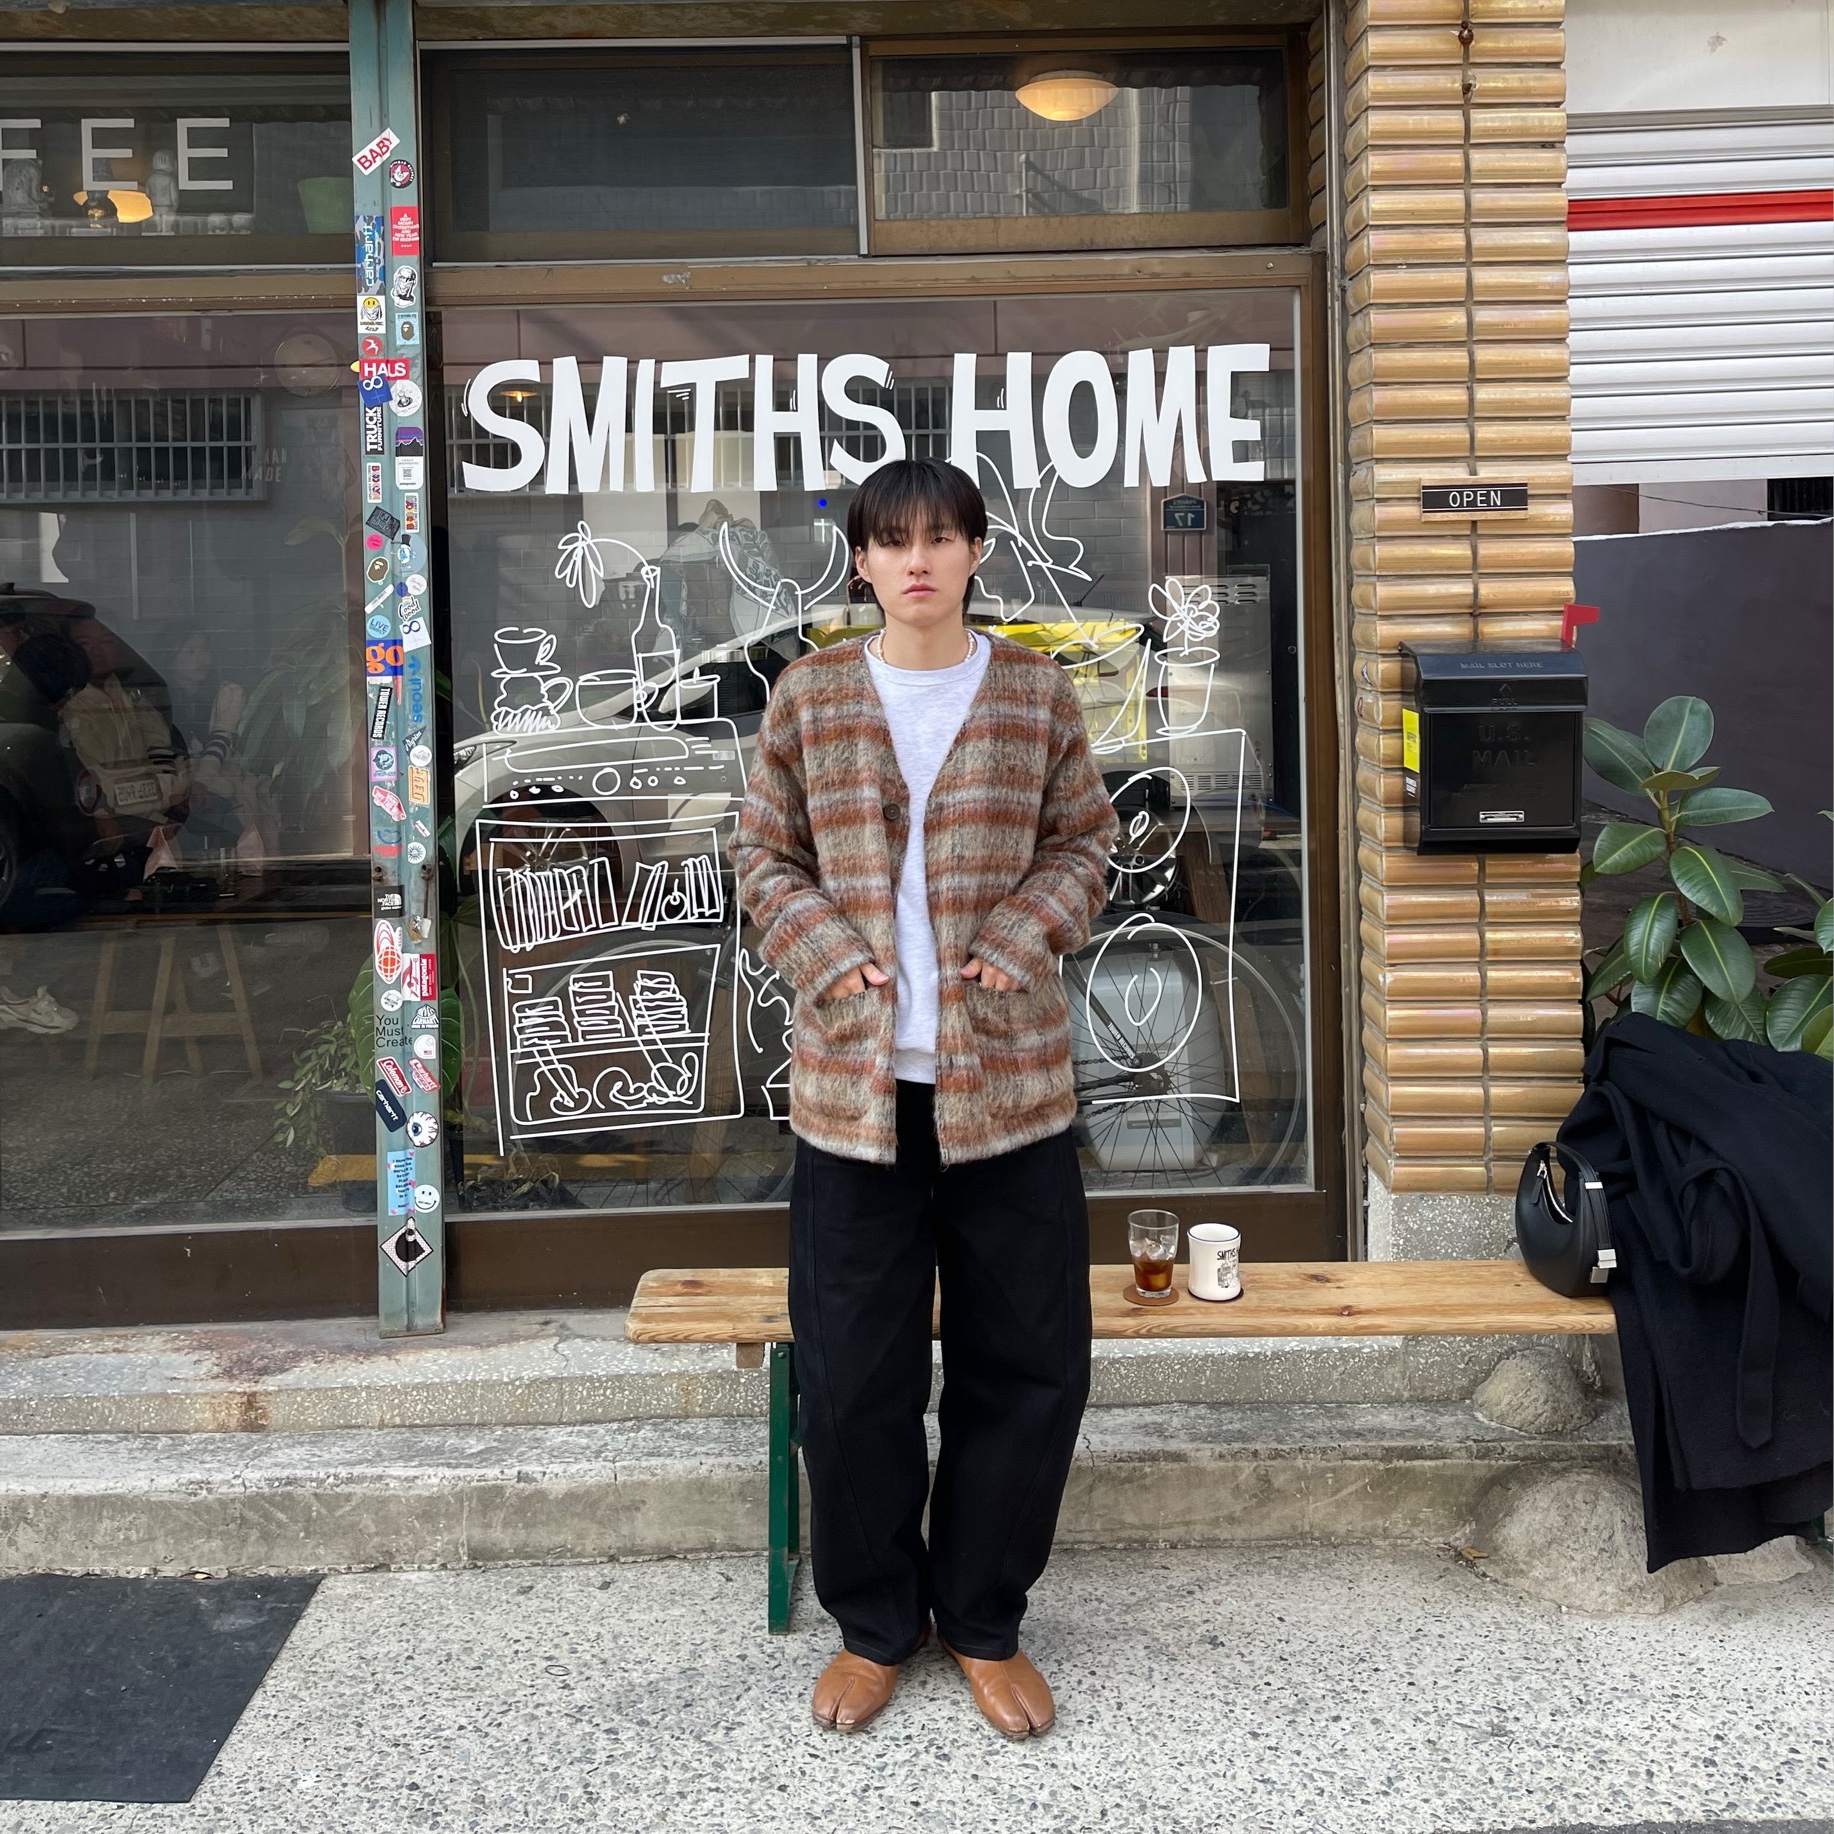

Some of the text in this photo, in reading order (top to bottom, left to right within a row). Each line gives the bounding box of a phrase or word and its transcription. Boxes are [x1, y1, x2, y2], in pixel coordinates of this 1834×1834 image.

[356, 131, 393, 171] BABY
[363, 224, 375, 287] carhartt
[363, 362, 407, 378] HAUS
[365, 406, 378, 452] TRUCK
[461, 343, 1271, 495] SMITHS HOME
[1449, 490, 1501, 507] OPEN
[370, 618, 389, 632] LIVE
[366, 643, 404, 674] go
[408, 678, 423, 723] seoul
[420, 958, 429, 997] patagonia
[375, 1014, 399, 1027] You
[375, 1026, 404, 1037] Must
[375, 1036, 413, 1048] Create
[382, 1059, 408, 1095] Coleman
[375, 1089, 399, 1122] carhartt
